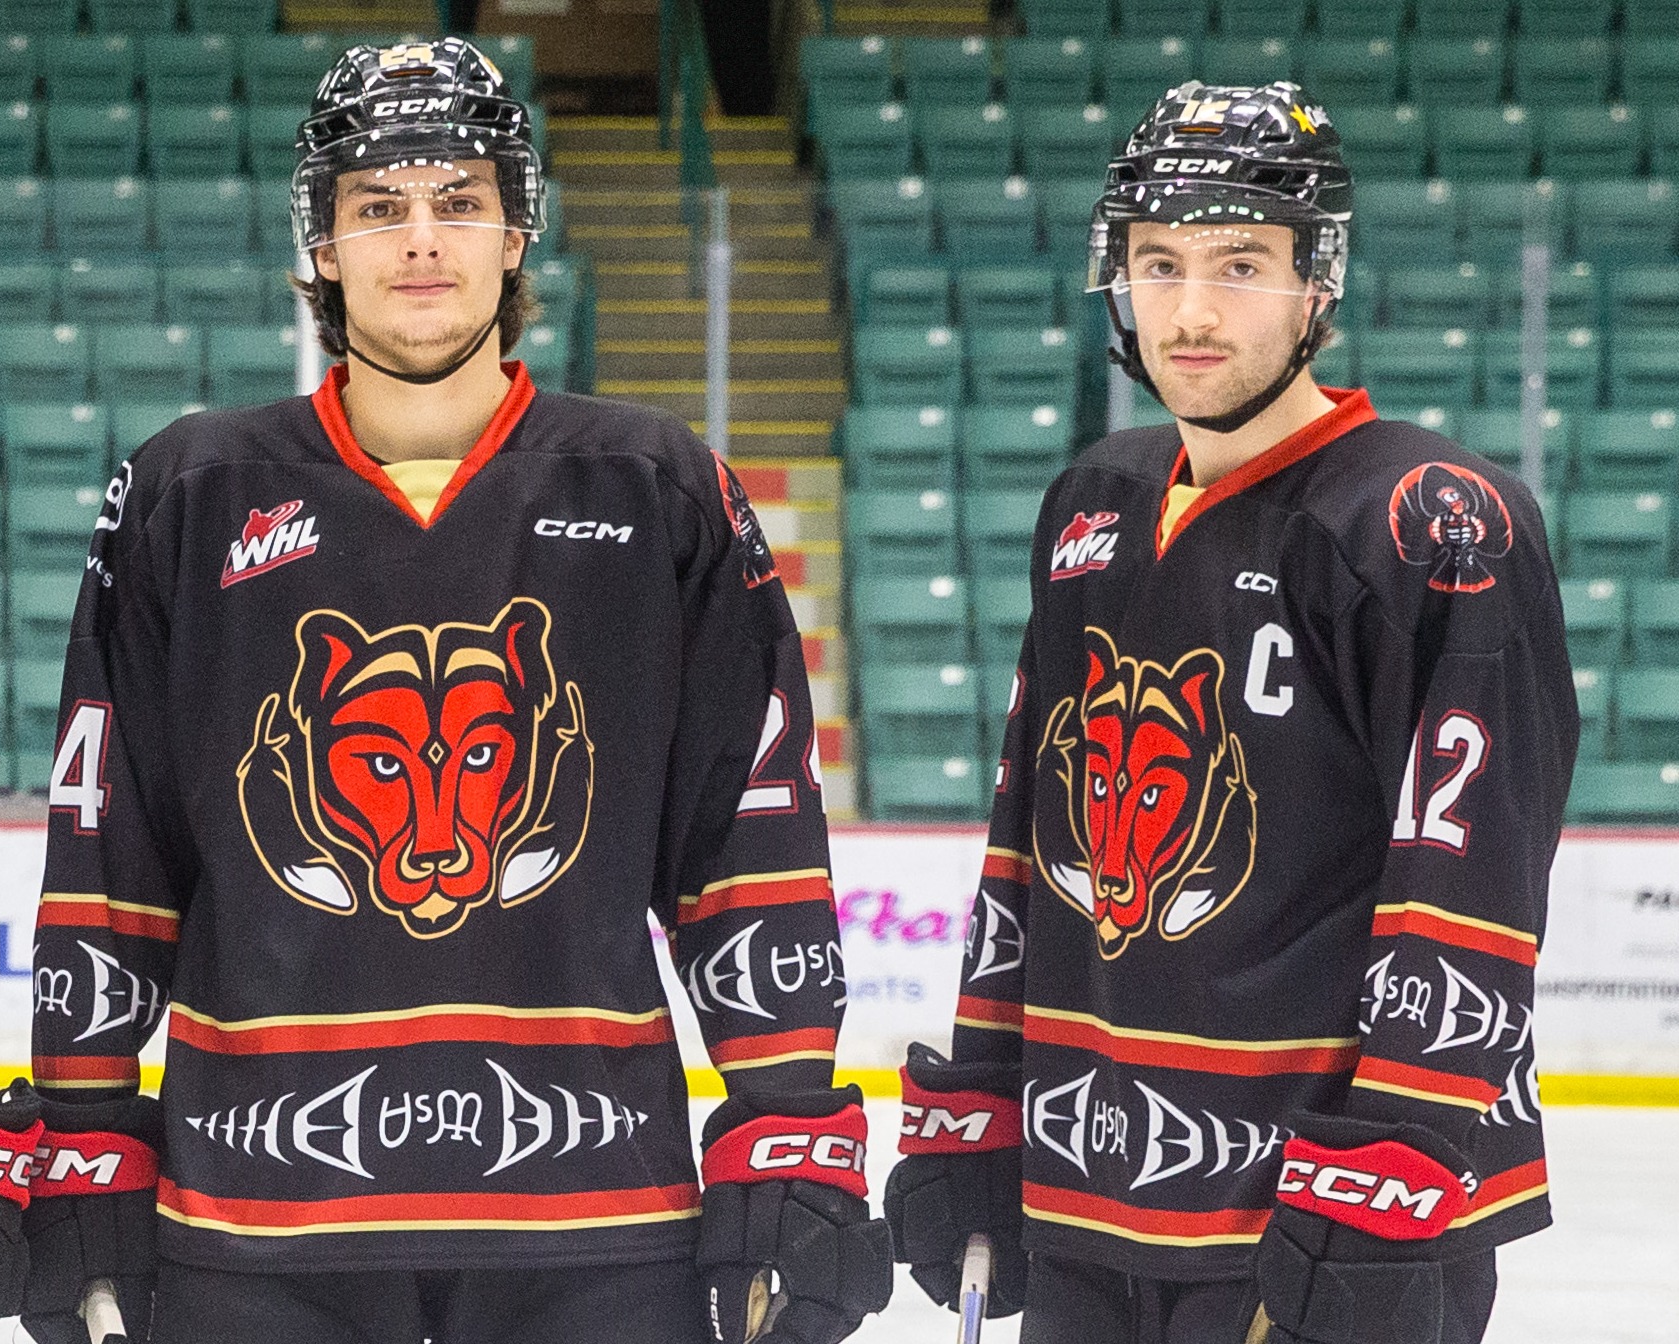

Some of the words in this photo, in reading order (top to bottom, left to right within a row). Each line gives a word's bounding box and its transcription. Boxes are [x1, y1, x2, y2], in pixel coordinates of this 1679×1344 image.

[373, 97, 453, 118] CCM
[1153, 158, 1234, 174] CCM
[230, 515, 320, 573] WHL
[534, 518, 634, 543] CCM
[1051, 532, 1120, 572] WHL
[1244, 622, 1294, 717] C
[1392, 714, 1486, 849] 12
[748, 1134, 866, 1173] CC
[1277, 1159, 1444, 1219] CCM
